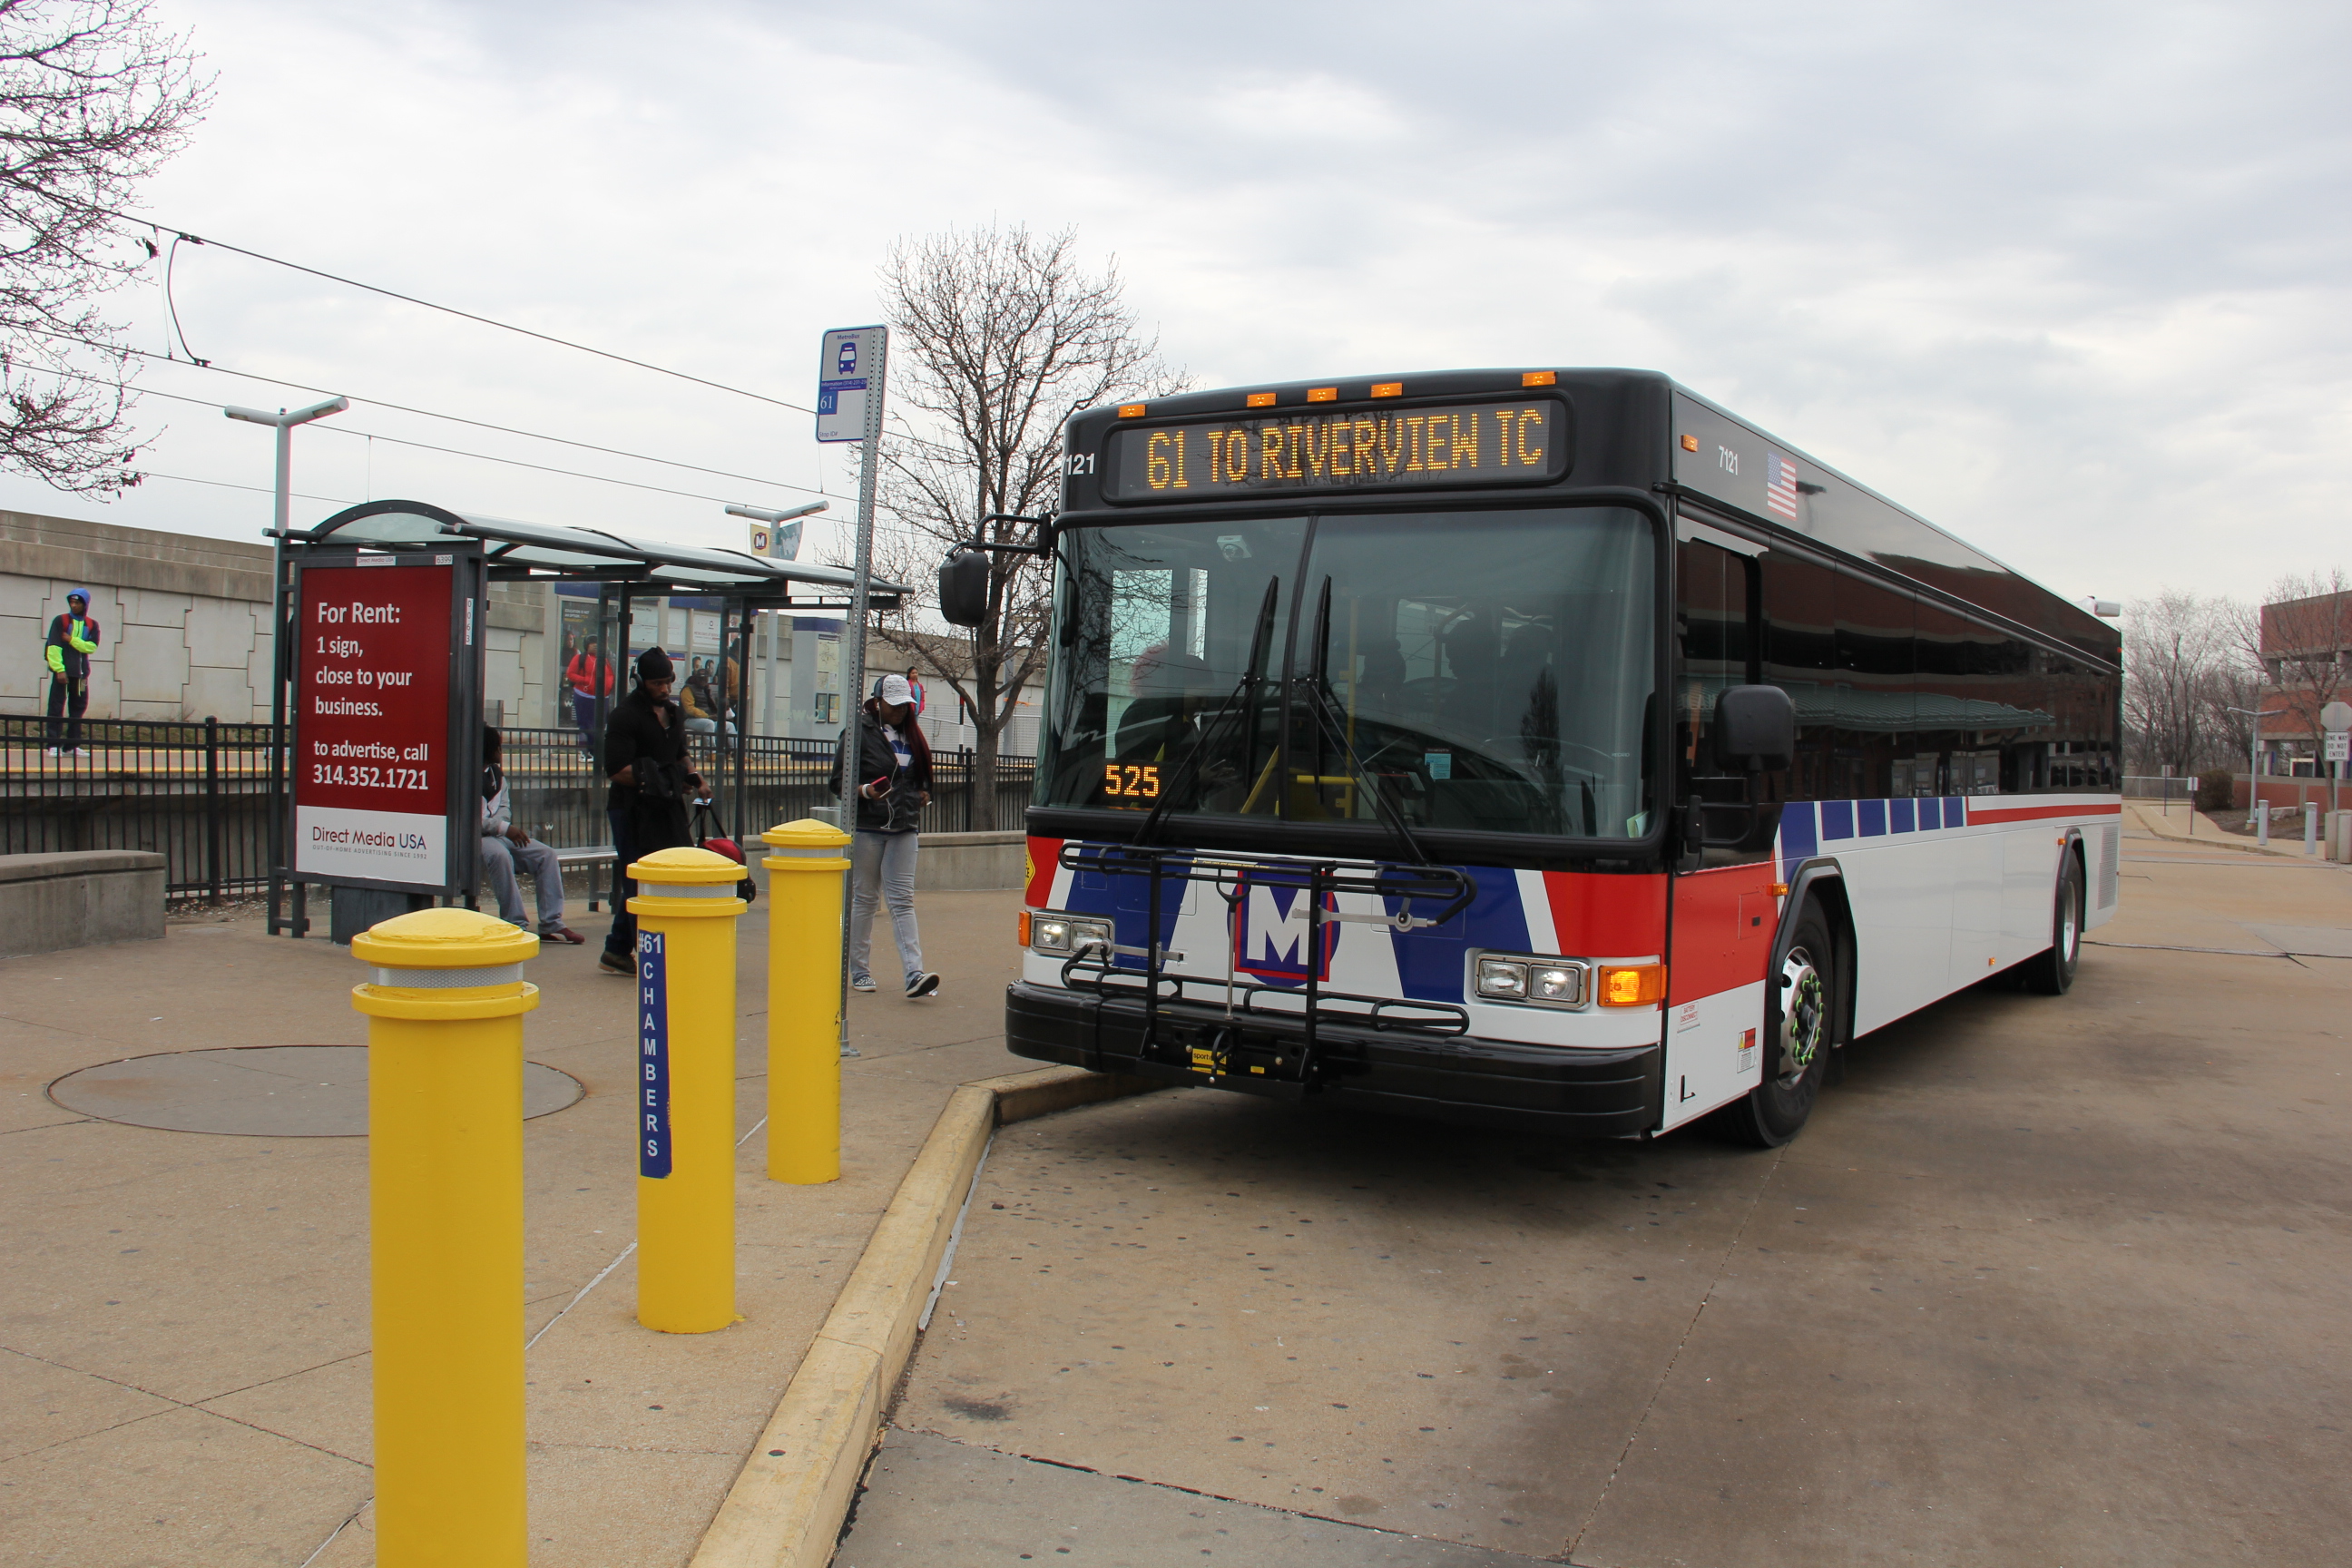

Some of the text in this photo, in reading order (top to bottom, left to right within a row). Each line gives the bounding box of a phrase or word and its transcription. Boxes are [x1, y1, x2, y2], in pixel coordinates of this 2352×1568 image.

[820, 396, 833, 409] 61
[1148, 409, 1542, 489] 61 TO RIVERVIEW TC
[1719, 445, 1738, 475] 7121
[318, 602, 400, 623] For Rent:
[317, 636, 364, 658] 1 sign,
[316, 665, 413, 690] close to your
[315, 696, 383, 716] business.
[314, 740, 428, 762] to advertise, call
[313, 764, 429, 790] 314.352.1721
[1105, 764, 1159, 797] 525
[312, 826, 426, 850] Direct Media USA
[312, 845, 352, 853] OUT-OF-HOME
[354, 848, 392, 857] ADVERTISING
[1247, 884, 1311, 965] M
[639, 933, 662, 954] #61
[643, 962, 658, 1157] CHAMBERS
